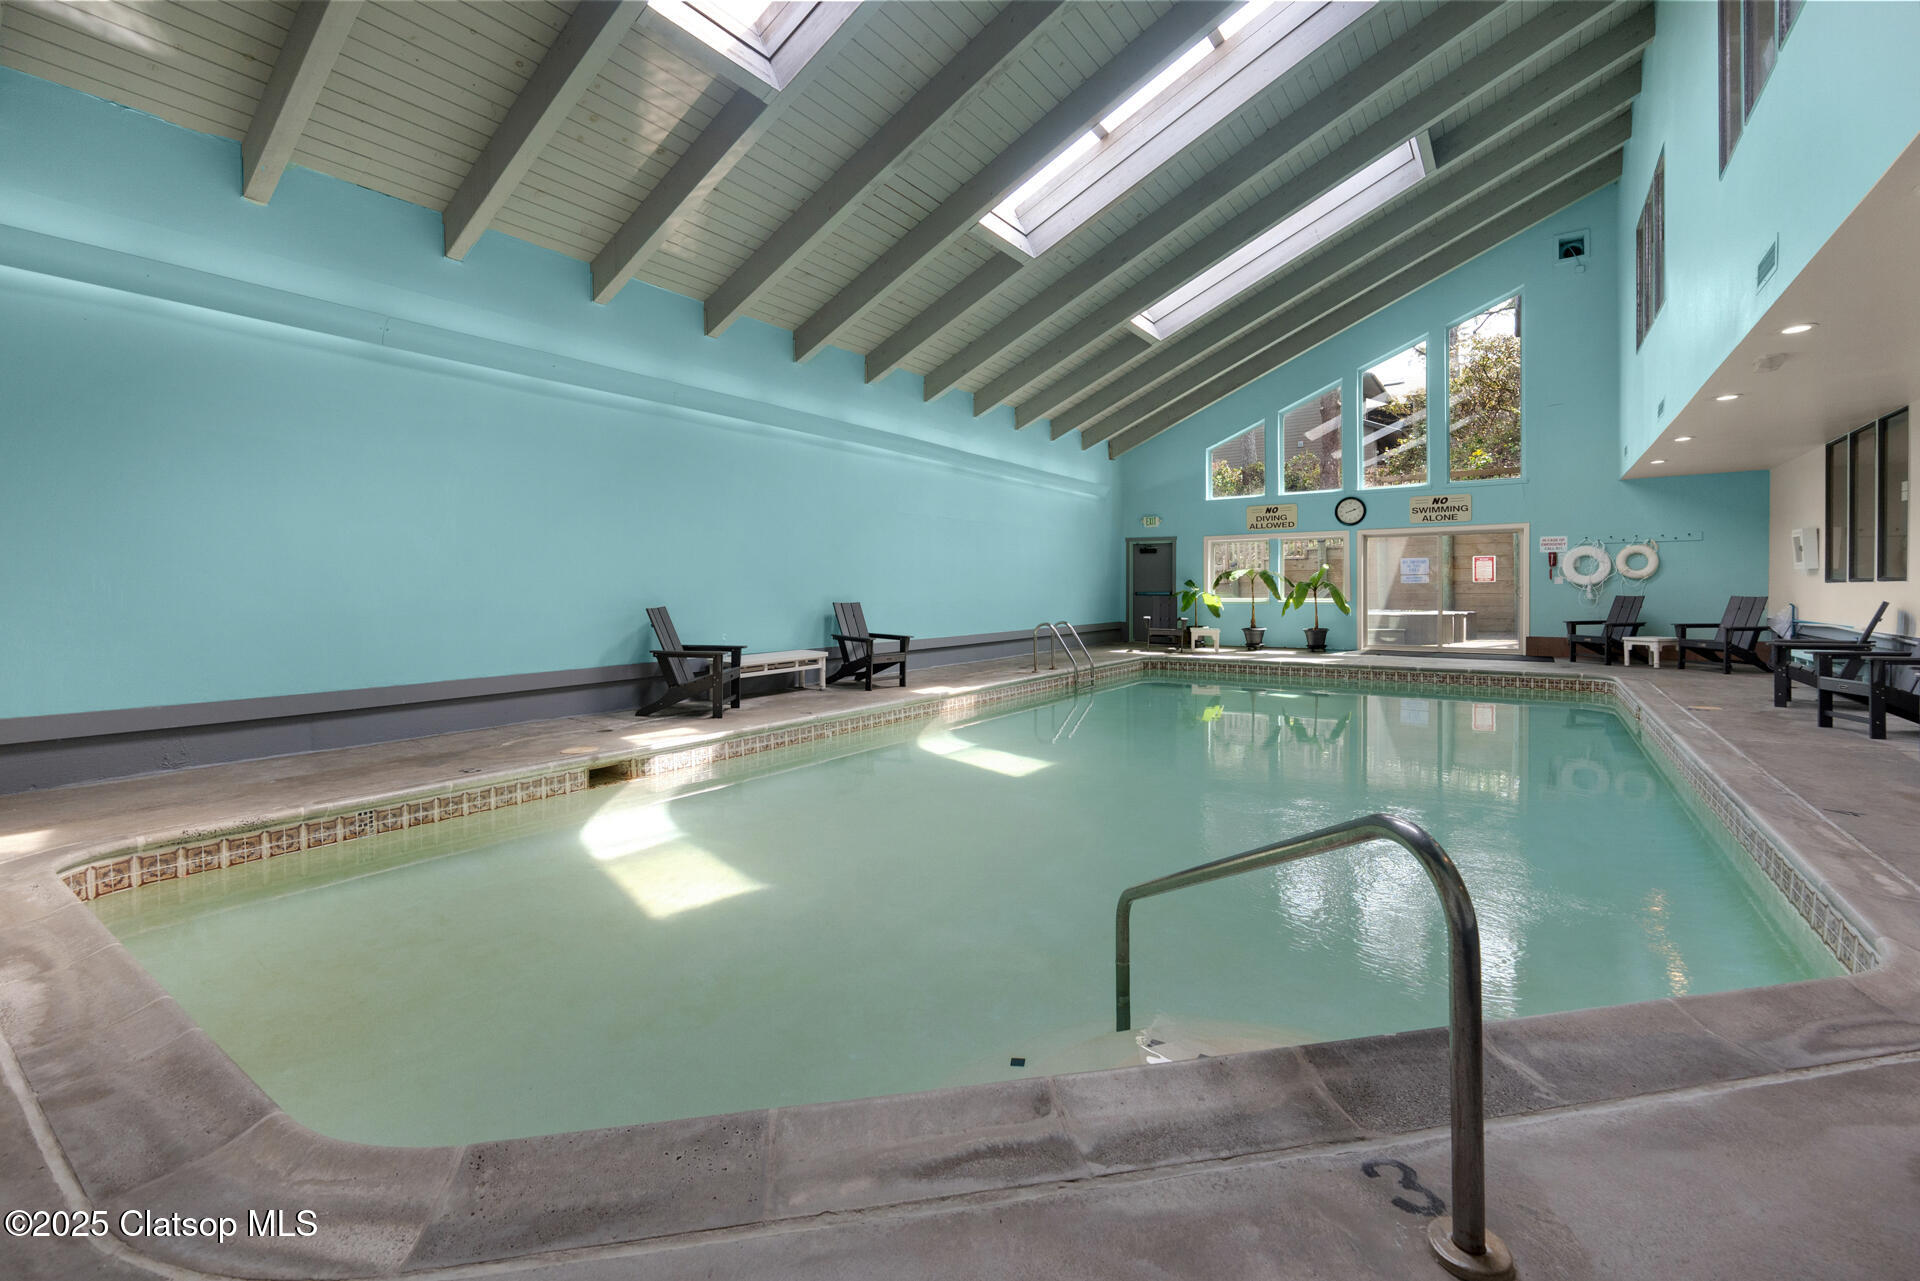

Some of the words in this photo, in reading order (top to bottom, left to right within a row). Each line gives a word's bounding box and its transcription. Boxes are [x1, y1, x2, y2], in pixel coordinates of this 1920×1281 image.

[1432, 496, 1449, 505] NO
[1265, 506, 1279, 514] NO
[1411, 504, 1469, 514] SWIMMING
[1255, 514, 1288, 522] DIVING
[1422, 513, 1459, 522] ALONE
[1249, 521, 1295, 530] ALLOWED
[1361, 1158, 1447, 1217] 3
